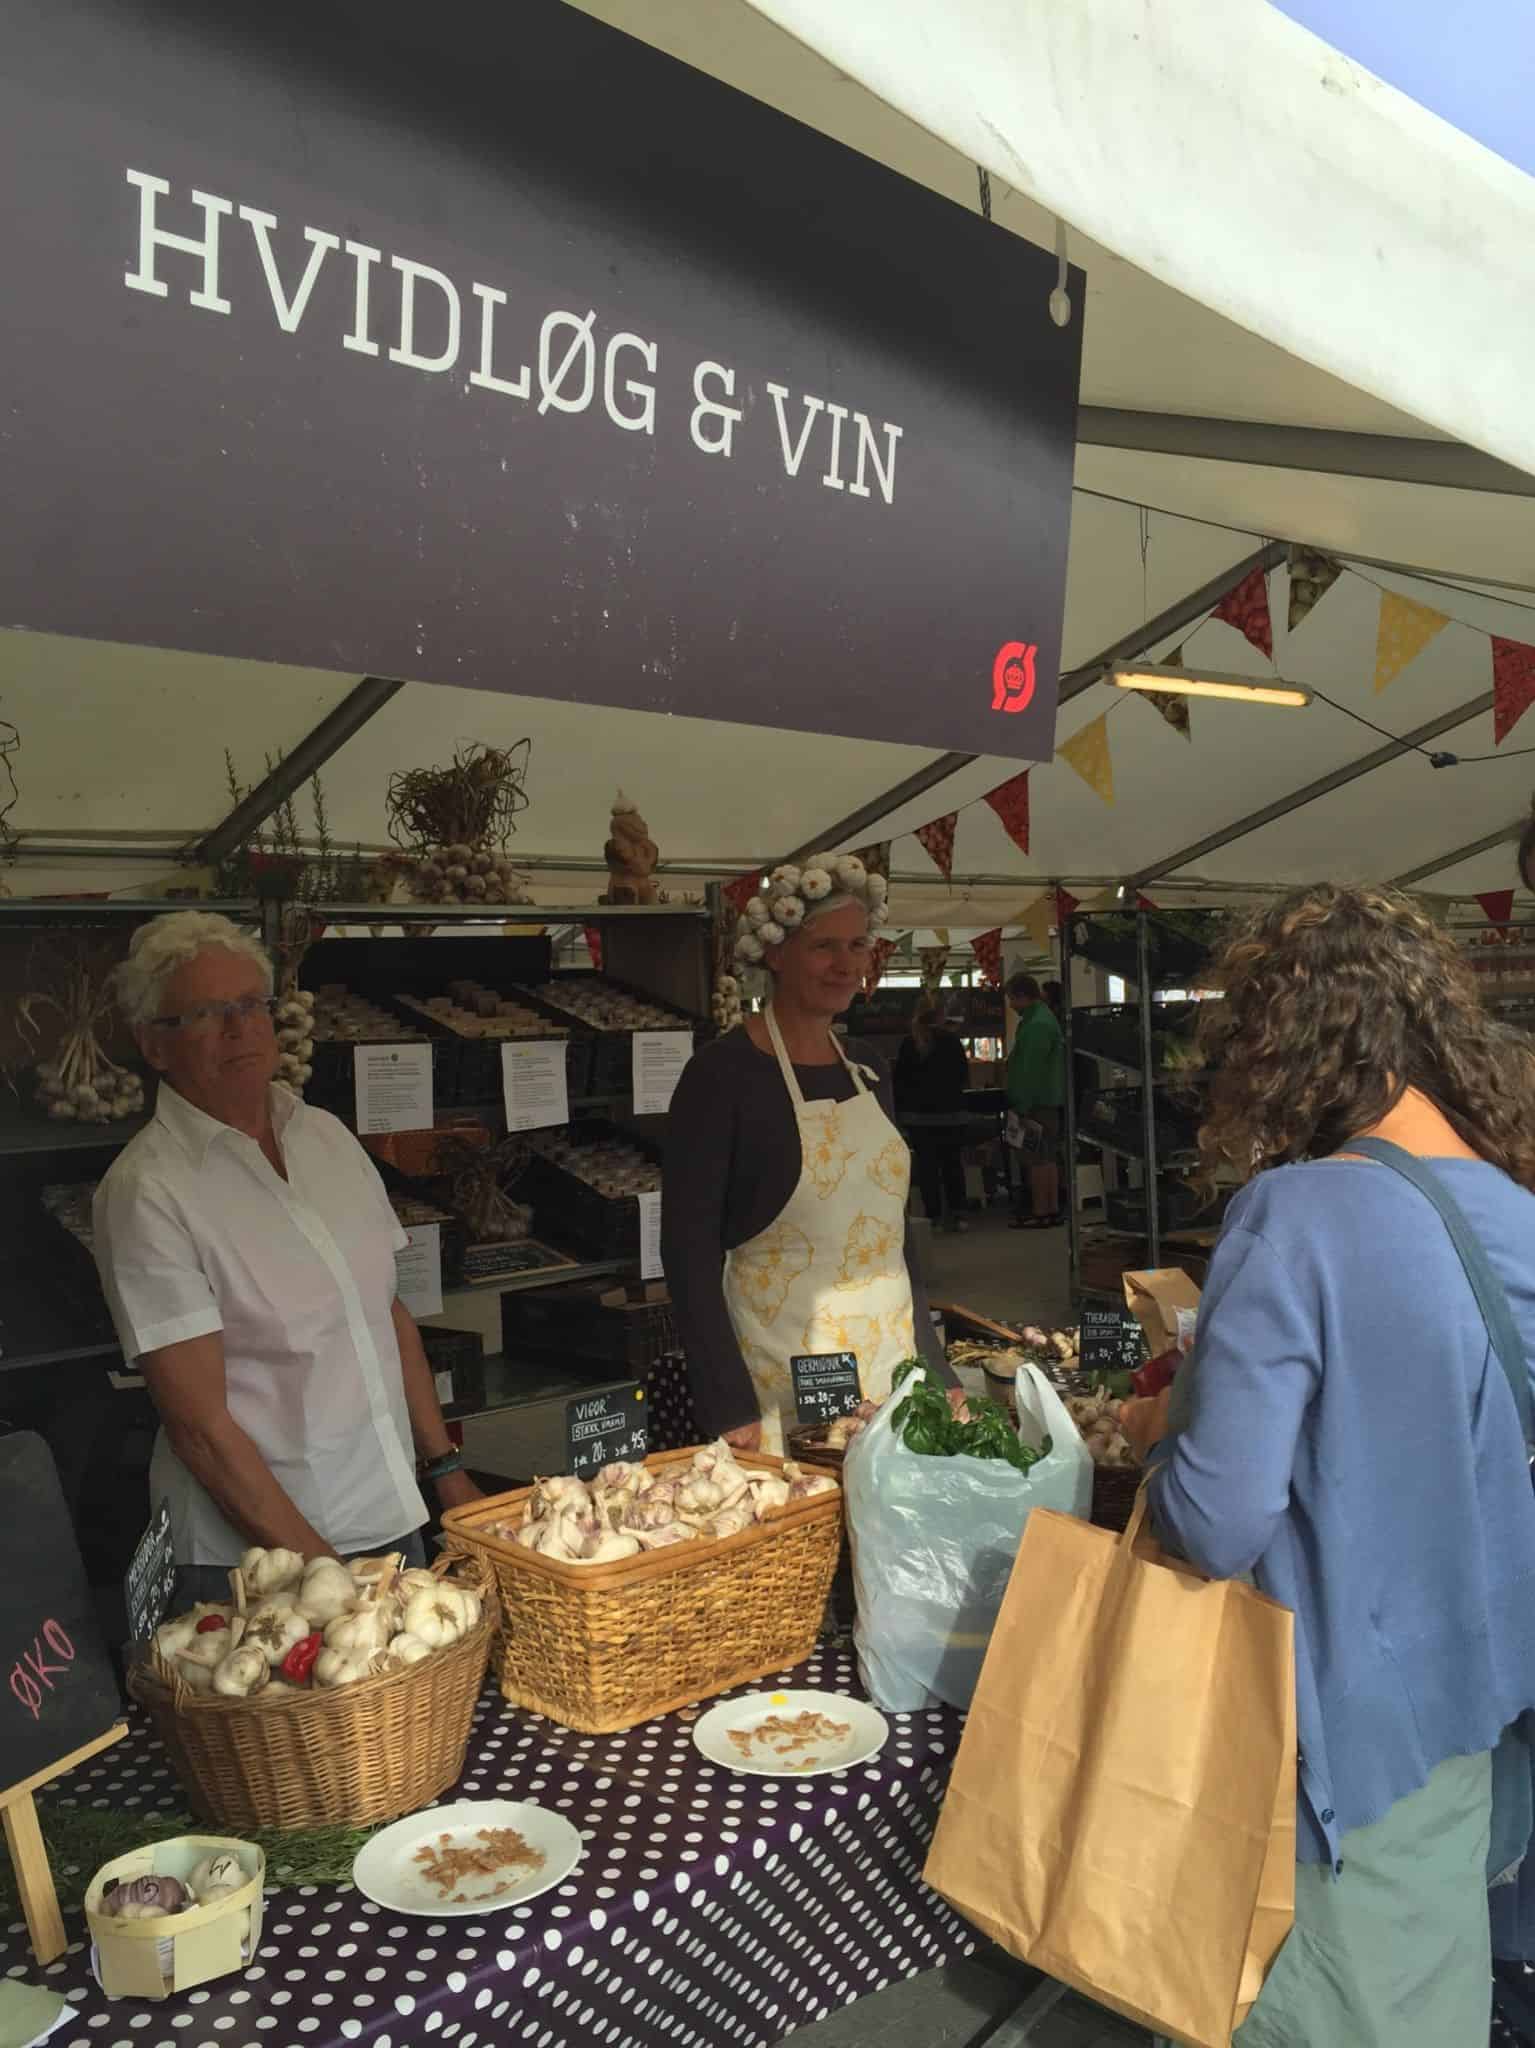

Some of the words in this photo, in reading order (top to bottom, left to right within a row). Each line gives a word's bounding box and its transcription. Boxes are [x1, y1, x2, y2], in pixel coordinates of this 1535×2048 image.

[125, 168, 658, 434] HVIDLØG
[690, 361, 743, 458] &
[767, 382, 903, 504] VIN
[575, 1398, 607, 1421] VIGOR
